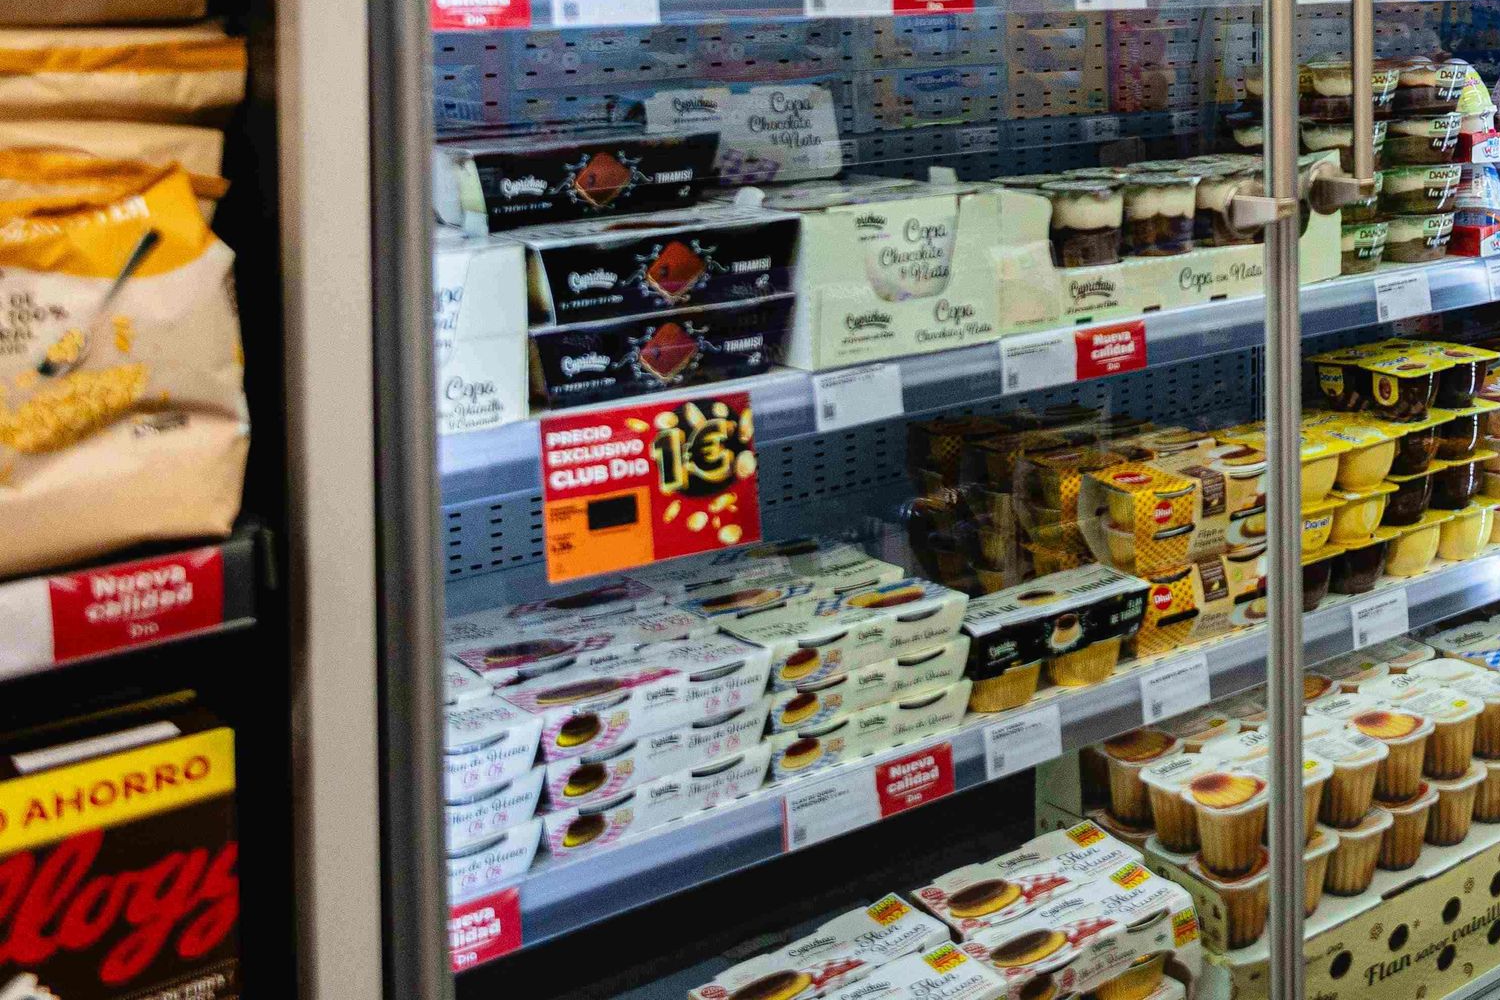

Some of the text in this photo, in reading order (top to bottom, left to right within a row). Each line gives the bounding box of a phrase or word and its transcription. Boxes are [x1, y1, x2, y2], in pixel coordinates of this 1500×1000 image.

[1091, 341, 1135, 360] calidad
[1092, 331, 1132, 346] Nueva
[546, 424, 613, 448] PRECIO
[547, 438, 645, 467] EXCLUSIVO
[550, 463, 608, 490] CLUB
[90, 563, 187, 600] Nueva
[85, 580, 194, 622] calidad
[886, 766, 941, 793] calidad
[888, 754, 935, 780] Nueva
[23, 754, 212, 829] AHORRO
[448, 905, 497, 931] ueva
[1364, 941, 1412, 986] Flan
[1413, 931, 1451, 965] sabor
